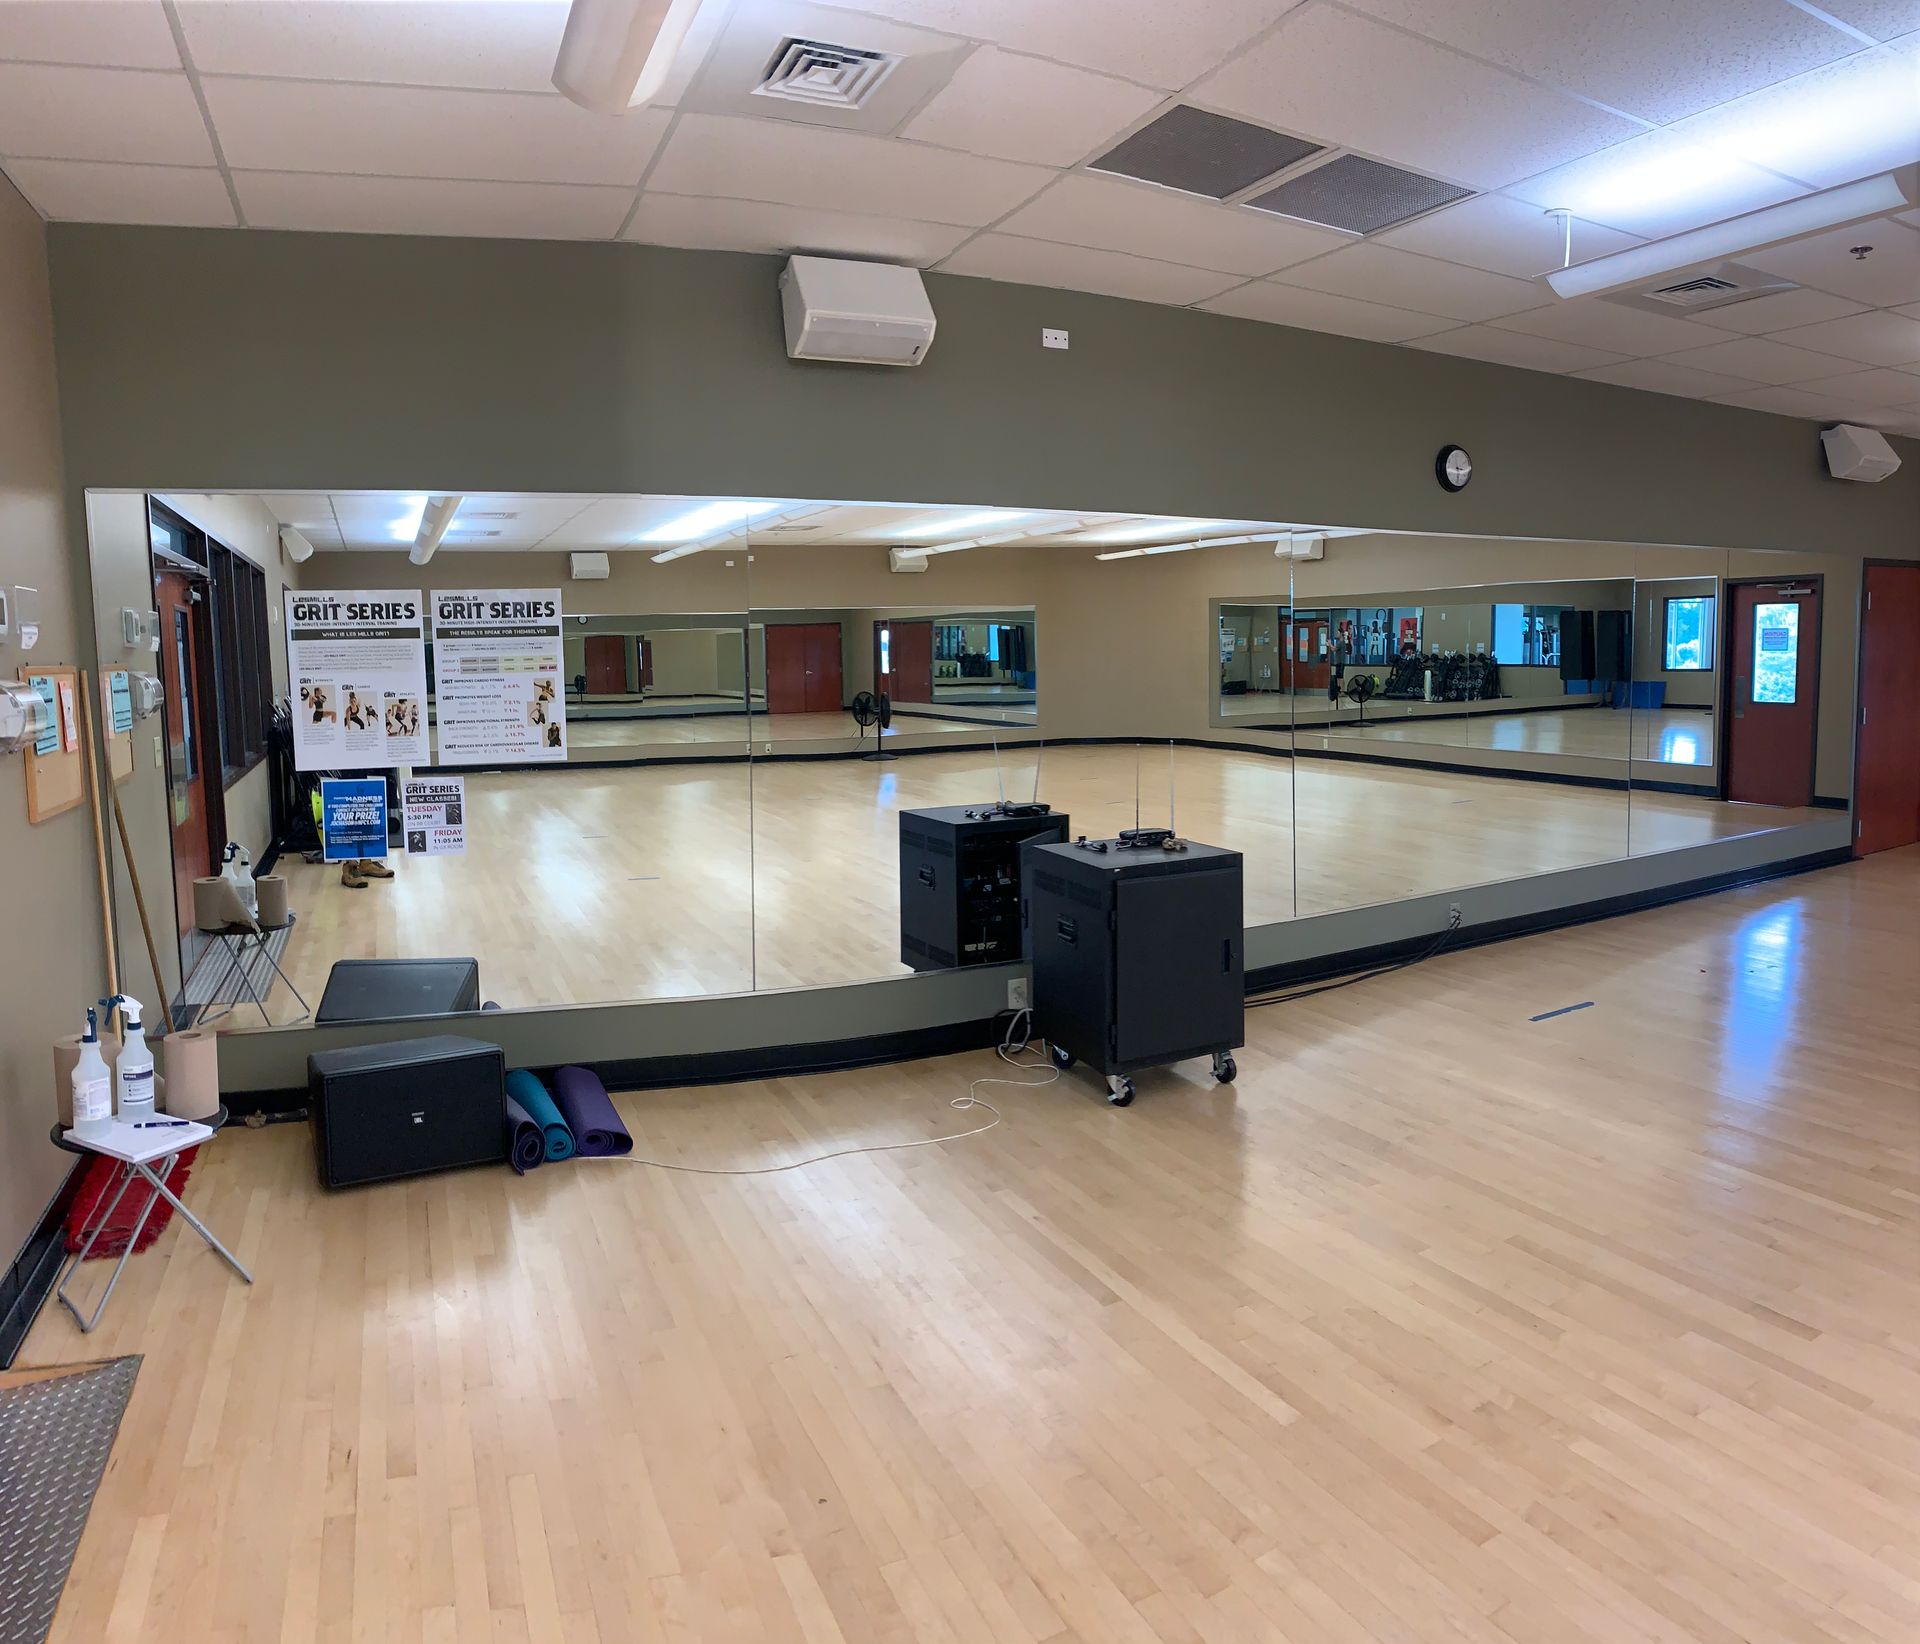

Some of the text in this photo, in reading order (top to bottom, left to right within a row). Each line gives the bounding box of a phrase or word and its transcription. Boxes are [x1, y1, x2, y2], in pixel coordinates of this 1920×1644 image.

[294, 602, 416, 620] GRIT SERIES
[439, 601, 555, 620] GRIT SERIES
[406, 785, 460, 794] GRIT SERIES
[333, 811, 380, 820] YOUR PRIZE!
